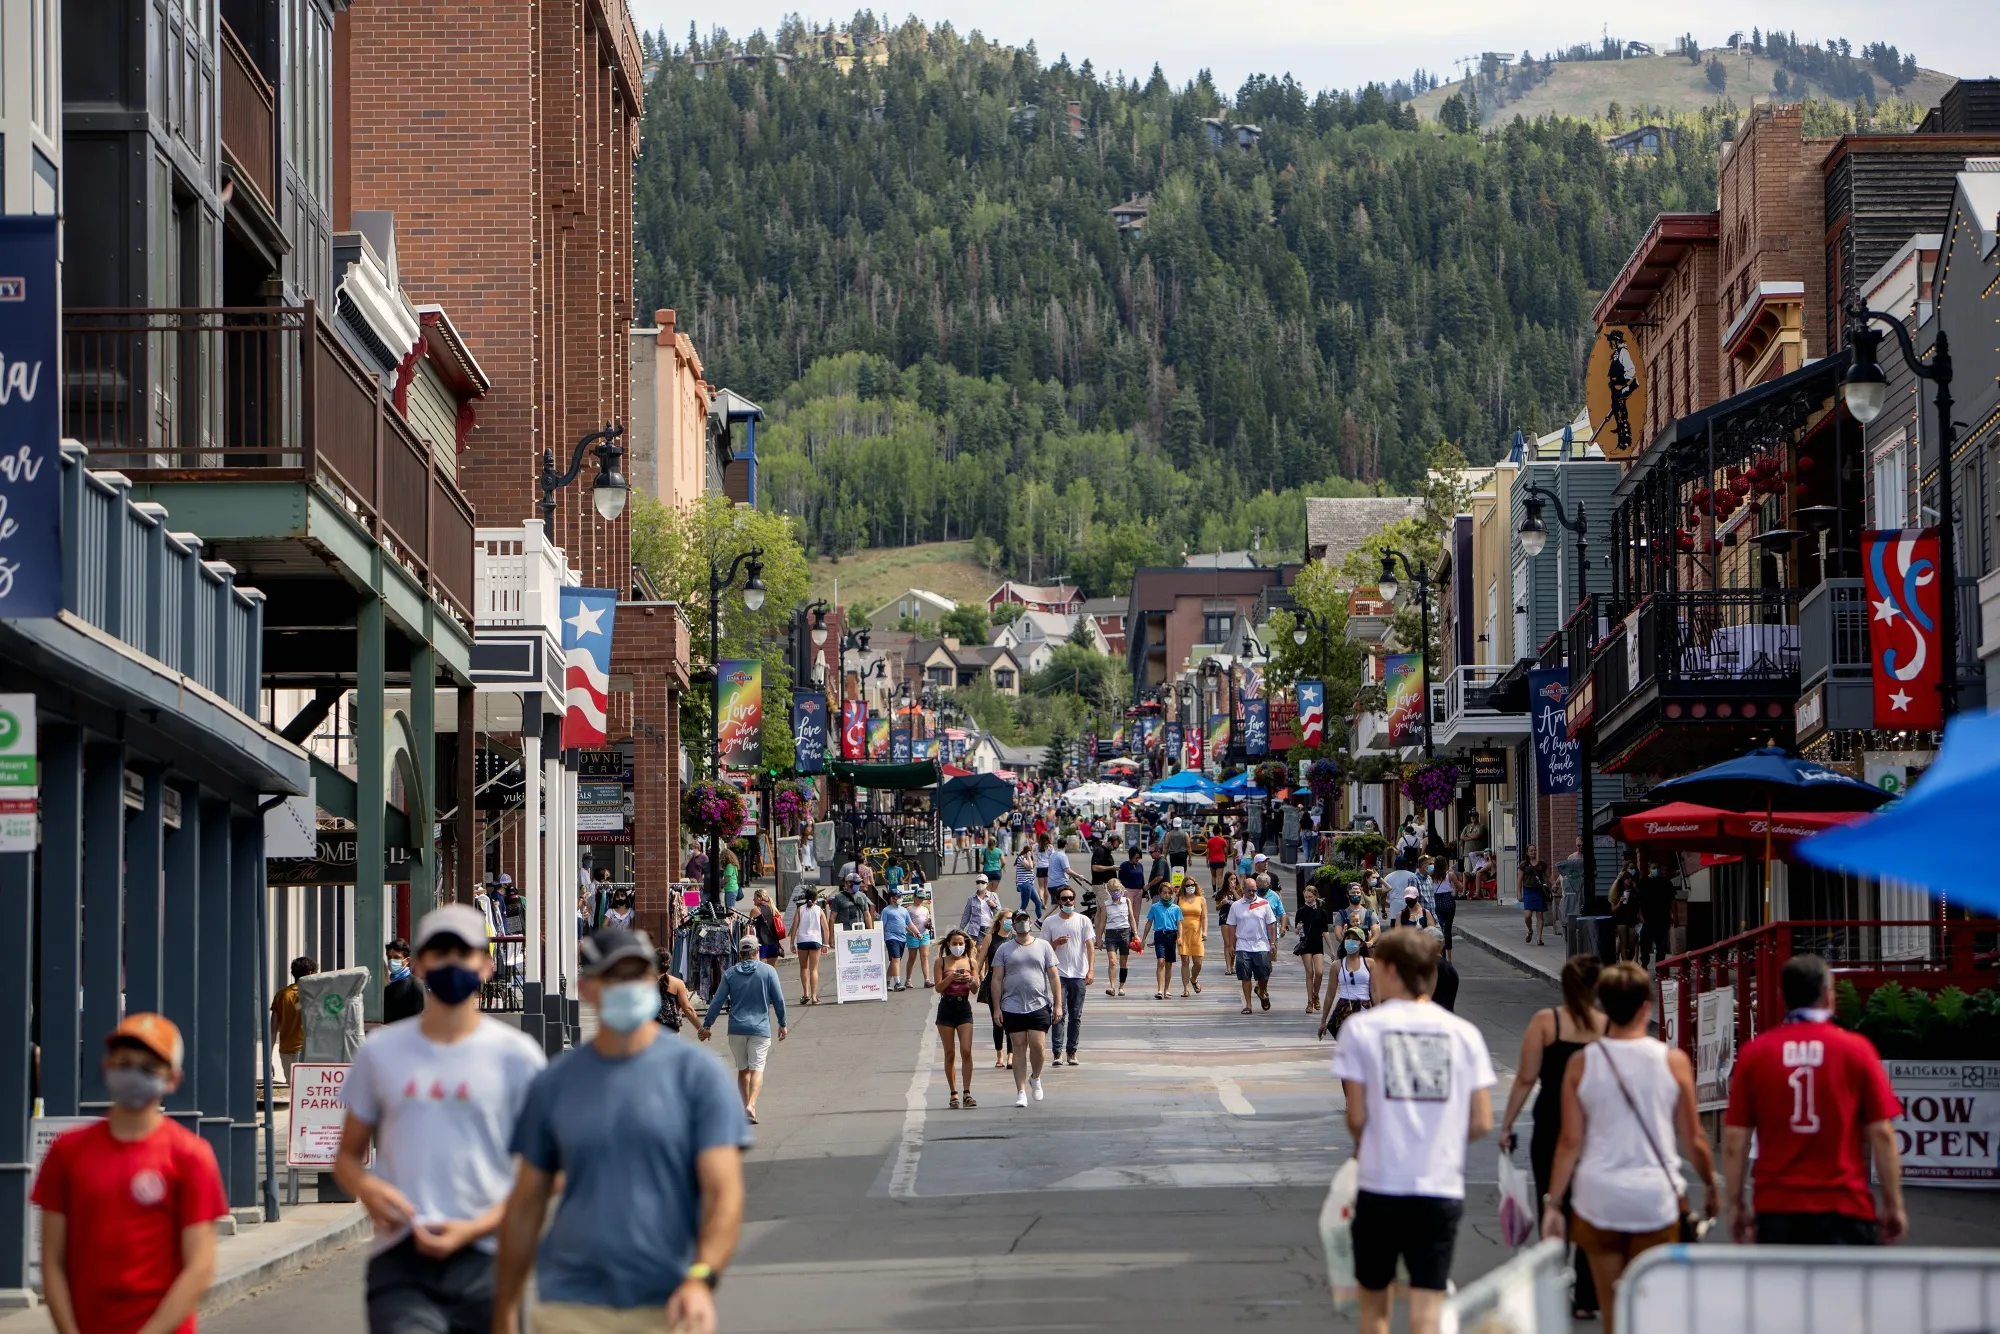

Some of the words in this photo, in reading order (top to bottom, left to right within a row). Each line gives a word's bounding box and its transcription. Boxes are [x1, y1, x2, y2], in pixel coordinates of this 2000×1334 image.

[1388, 682, 1421, 719] Love
[719, 692, 758, 732] Love
[1402, 710, 1423, 722] where
[736, 722, 759, 737] where
[795, 716, 822, 746] Love
[1393, 722, 1409, 737] you
[1408, 722, 1423, 734] live
[725, 738, 743, 754] you
[742, 738, 759, 751] live
[1540, 736, 1550, 755] el
[1552, 736, 1580, 756] lugar
[1475, 767, 1505, 776] Sotheby's
[1548, 754, 1574, 774] donde
[1550, 773, 1576, 787] vives
[1644, 822, 1699, 835] Budweiser
[320, 1070, 345, 1084] NO
[1894, 1066, 1958, 1077] BANGKOK
[1788, 1067, 1820, 1133] 1
